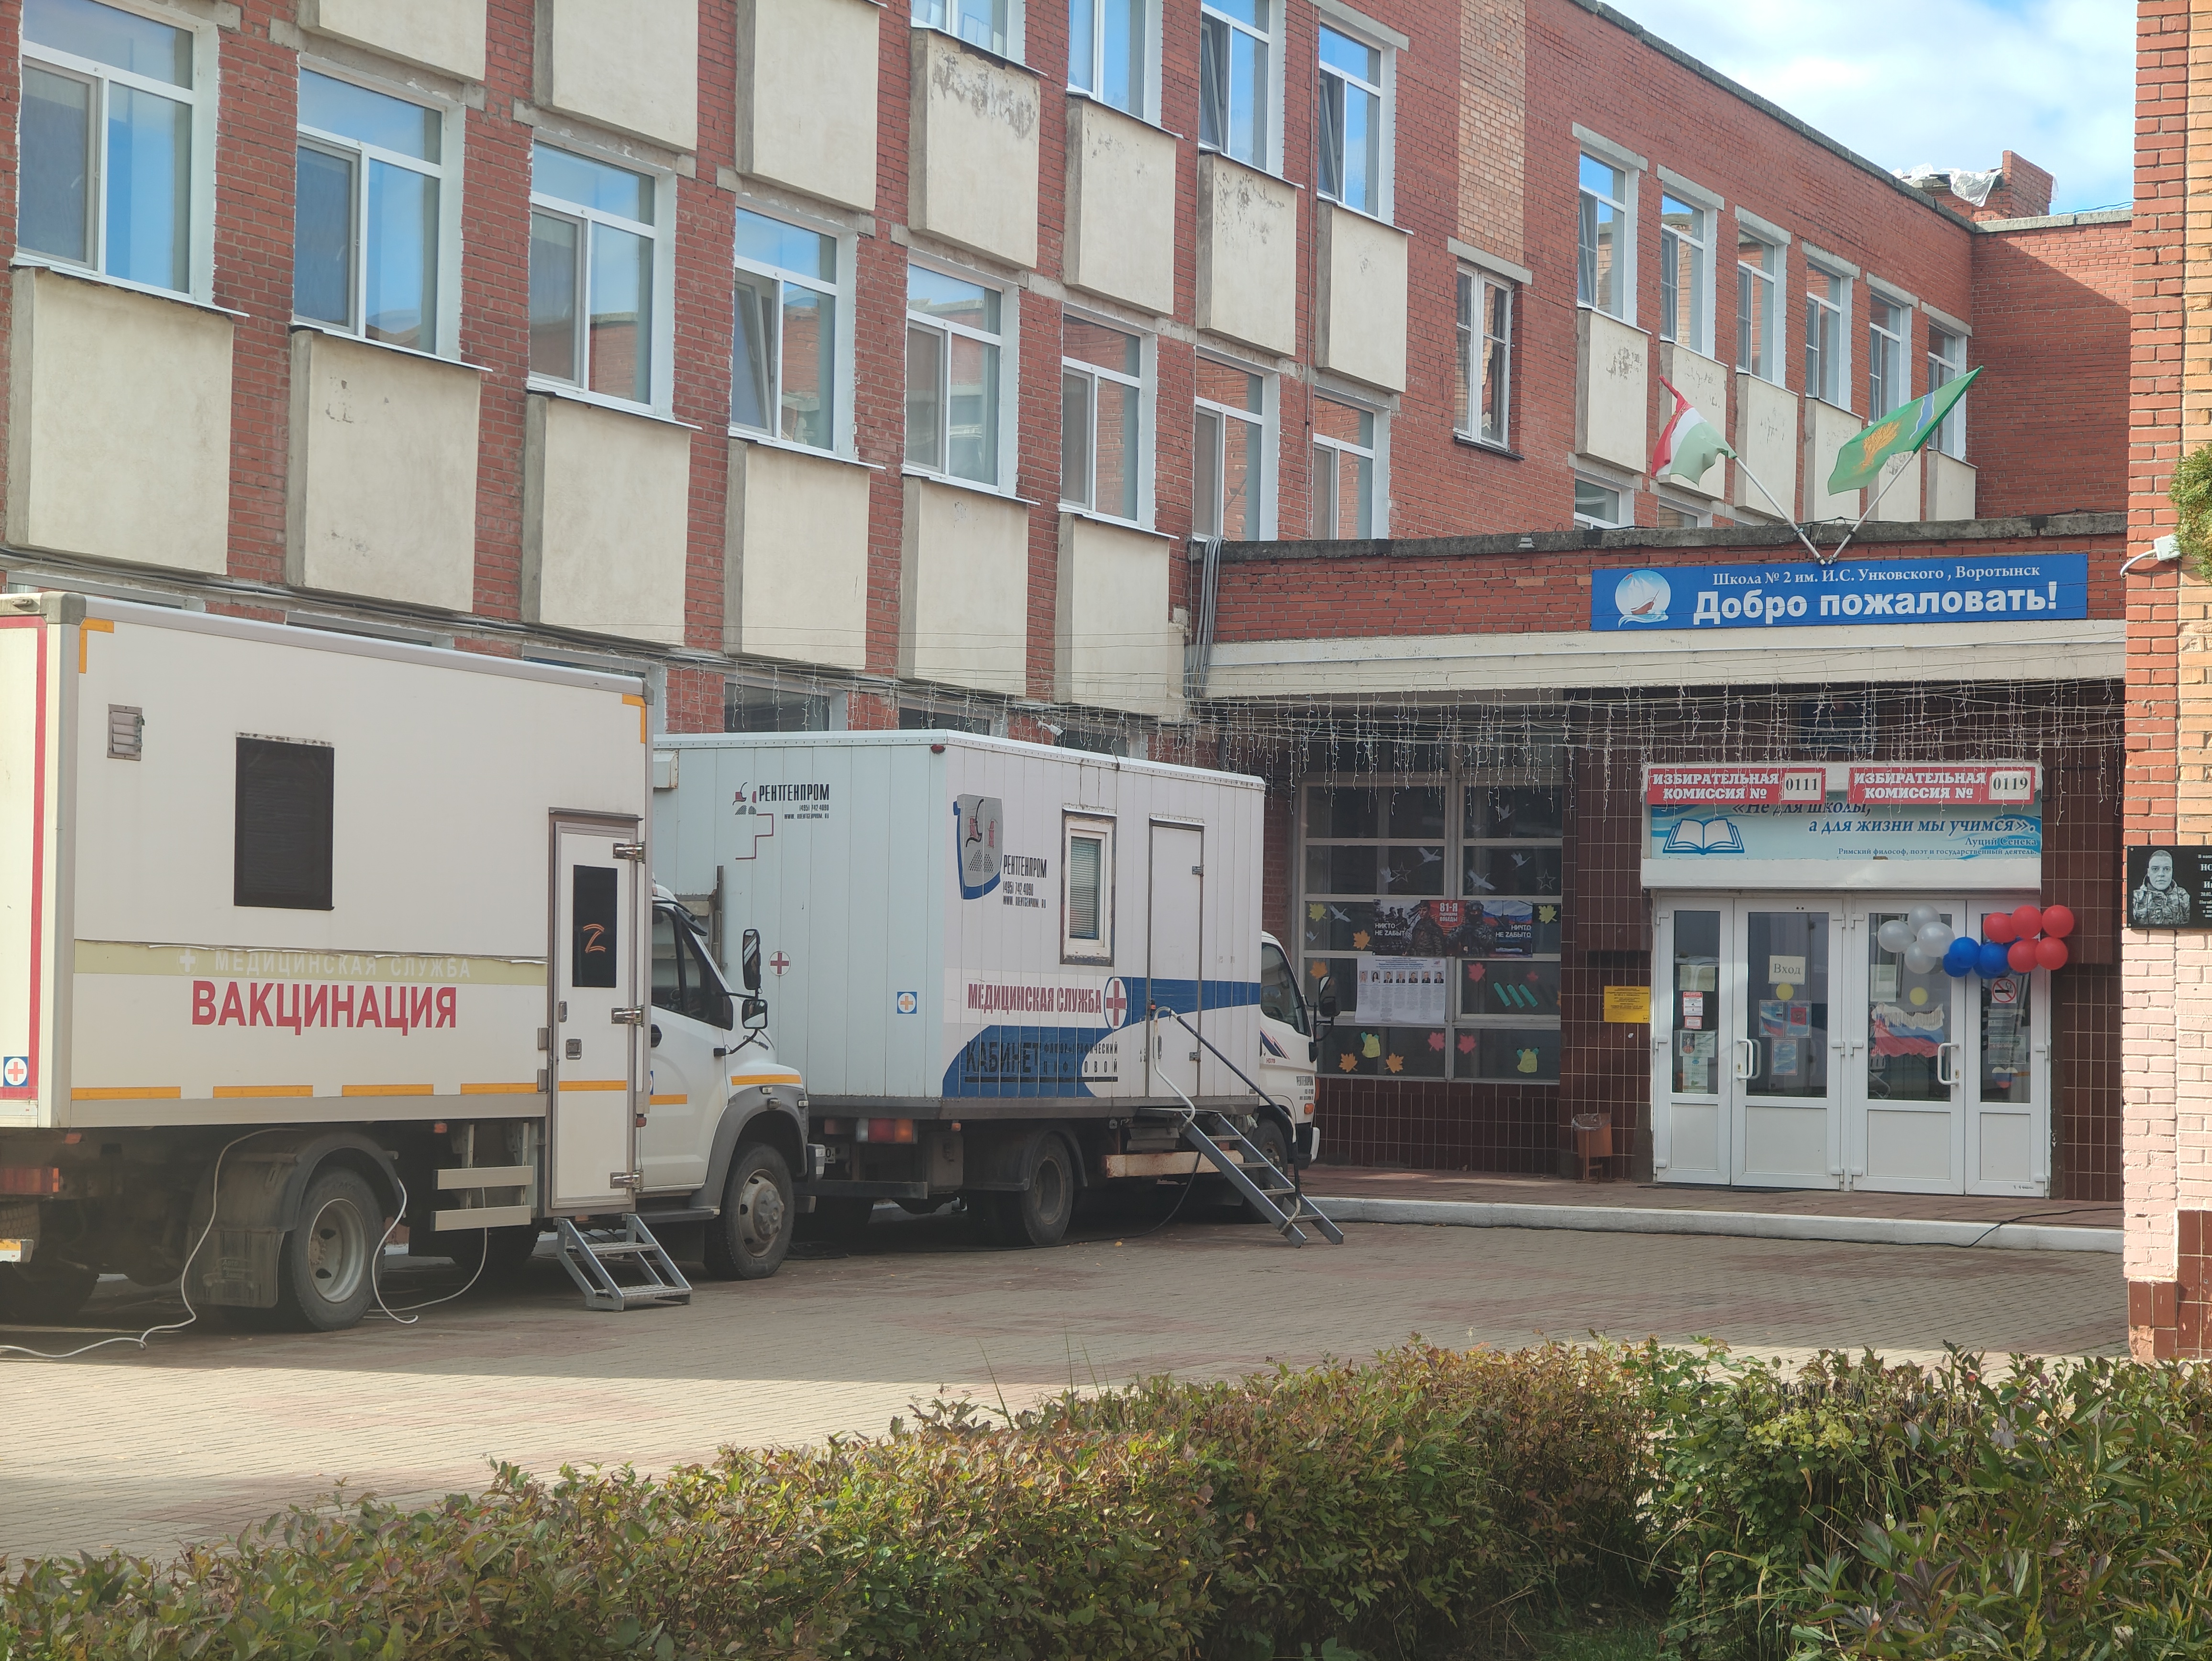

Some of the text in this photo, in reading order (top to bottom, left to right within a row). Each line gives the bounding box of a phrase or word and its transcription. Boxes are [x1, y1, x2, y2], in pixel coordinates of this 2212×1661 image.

[1713, 573, 1761, 585] Школа
[1765, 571, 1780, 584] №
[1783, 572, 1792, 583] 2
[1795, 574, 1818, 583] им.
[1822, 569, 1855, 582] И.С.
[1858, 568, 1944, 581] Унковского
[1955, 565, 2040, 581] Воротынск
[1693, 581, 2057, 625] Добро пожаловать!
[1653, 773, 1779, 785] ИЗБИРАТЕЛЬНАЯ
[1785, 778, 1818, 791] 0111
[1854, 773, 1986, 784] ИЗБИРАТЕЛЬНАЯ
[1993, 777, 2028, 790] 0119
[759, 784, 830, 802] РЕНТГЕНПРОМ
[1663, 787, 1767, 799] КОМИССИЯ №
[1865, 787, 1974, 798] КОМИССИЯ №
[1772, 804, 1803, 817] для
[1806, 802, 1871, 817] школы,
[1809, 819, 2036, 836] а для жизни мы учимся».
[1965, 837, 2037, 847] Луций Сенека
[1873, 848, 1908, 856] философ,
[1936, 848, 2003, 856] государственный
[1003, 854, 1047, 879] РЕНТГЕНПРОМ
[1003, 880, 1014, 894] (495)
[1023, 883, 1034, 896] 4090
[1439, 902, 1458, 912] 81-Я
[215, 949, 470, 978] МЕДИЦИНСКАЯ СЛУЖБА
[1773, 963, 1801, 975] Вход
[968, 983, 1102, 1015] МЕДИЦИНСКАЯ СЛУЖБА
[192, 979, 457, 1036] ВАКЦИНАЦИЯ
[966, 1041, 1040, 1073] КАБИНЕТ
[1043, 1058, 1118, 1075] ЦИФОВОЙ
